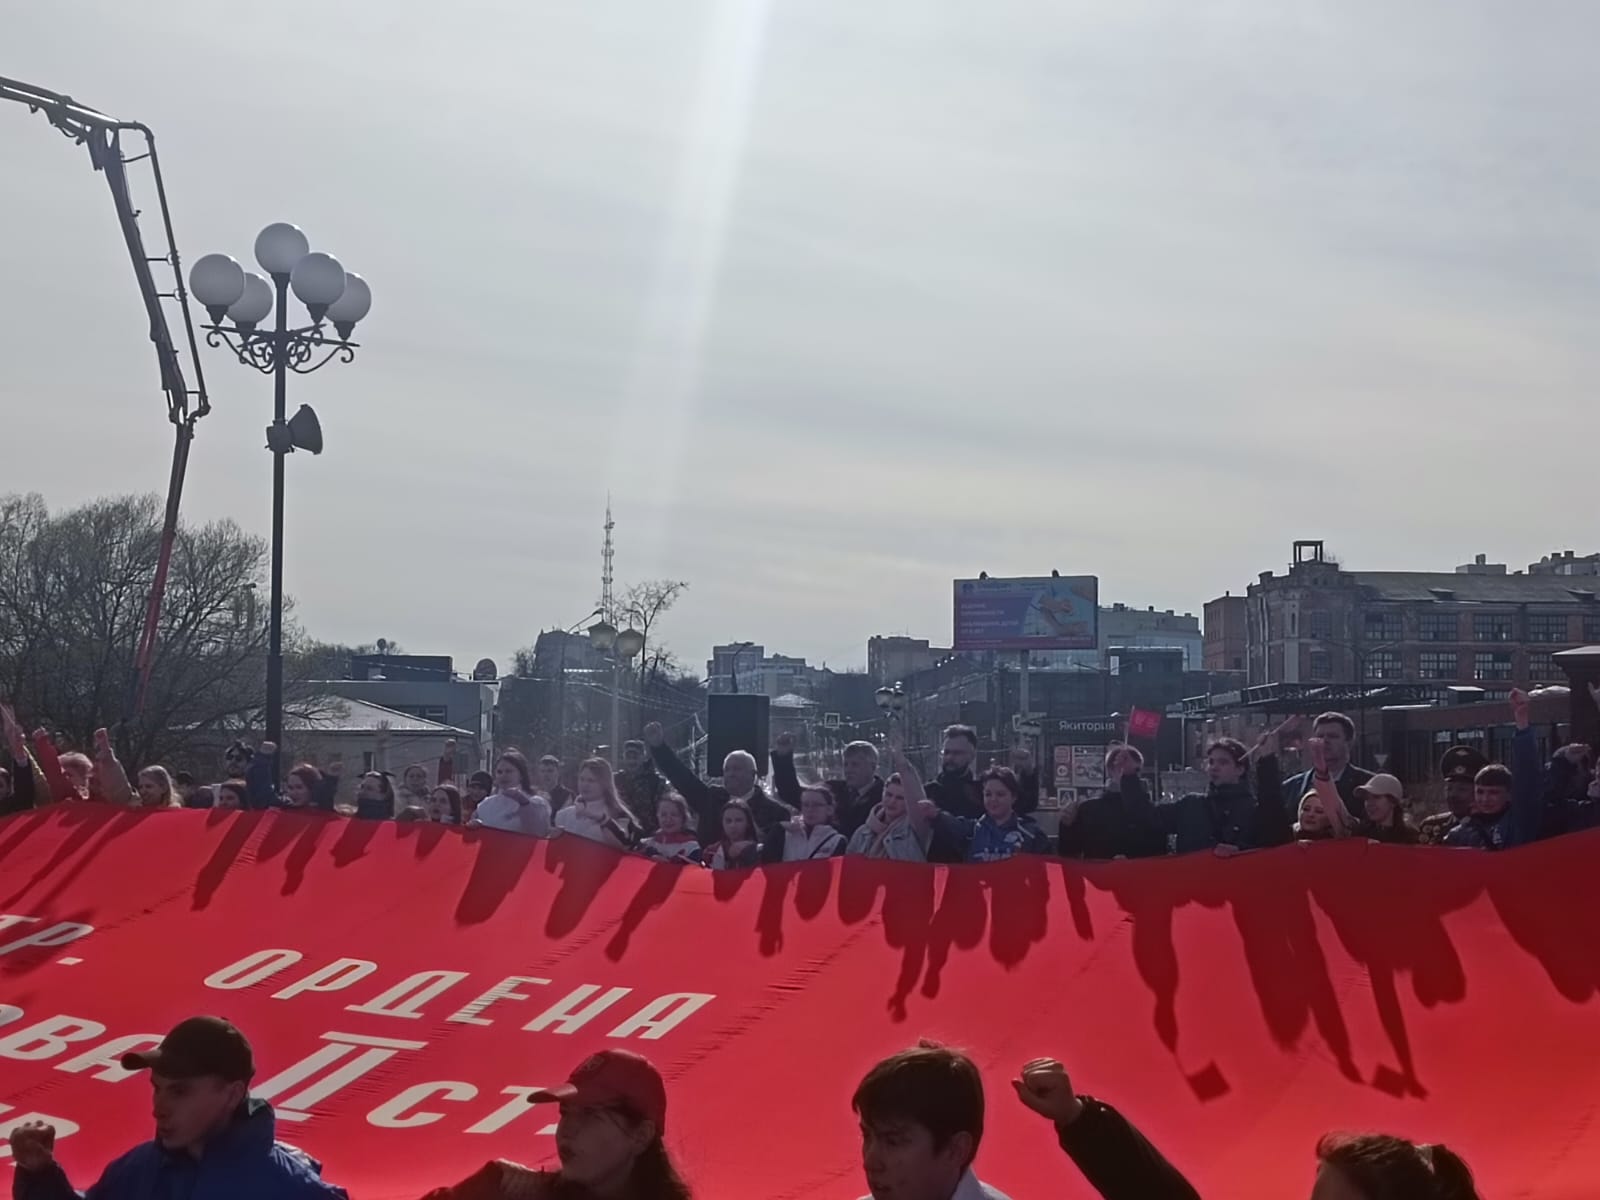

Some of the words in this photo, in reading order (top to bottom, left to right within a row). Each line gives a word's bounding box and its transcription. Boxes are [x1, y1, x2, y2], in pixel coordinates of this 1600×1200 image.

[1058, 720, 1116, 732] Якитория
[203, 948, 717, 1040] ОРДЕНА
[0, 1004, 168, 1083] ВА
